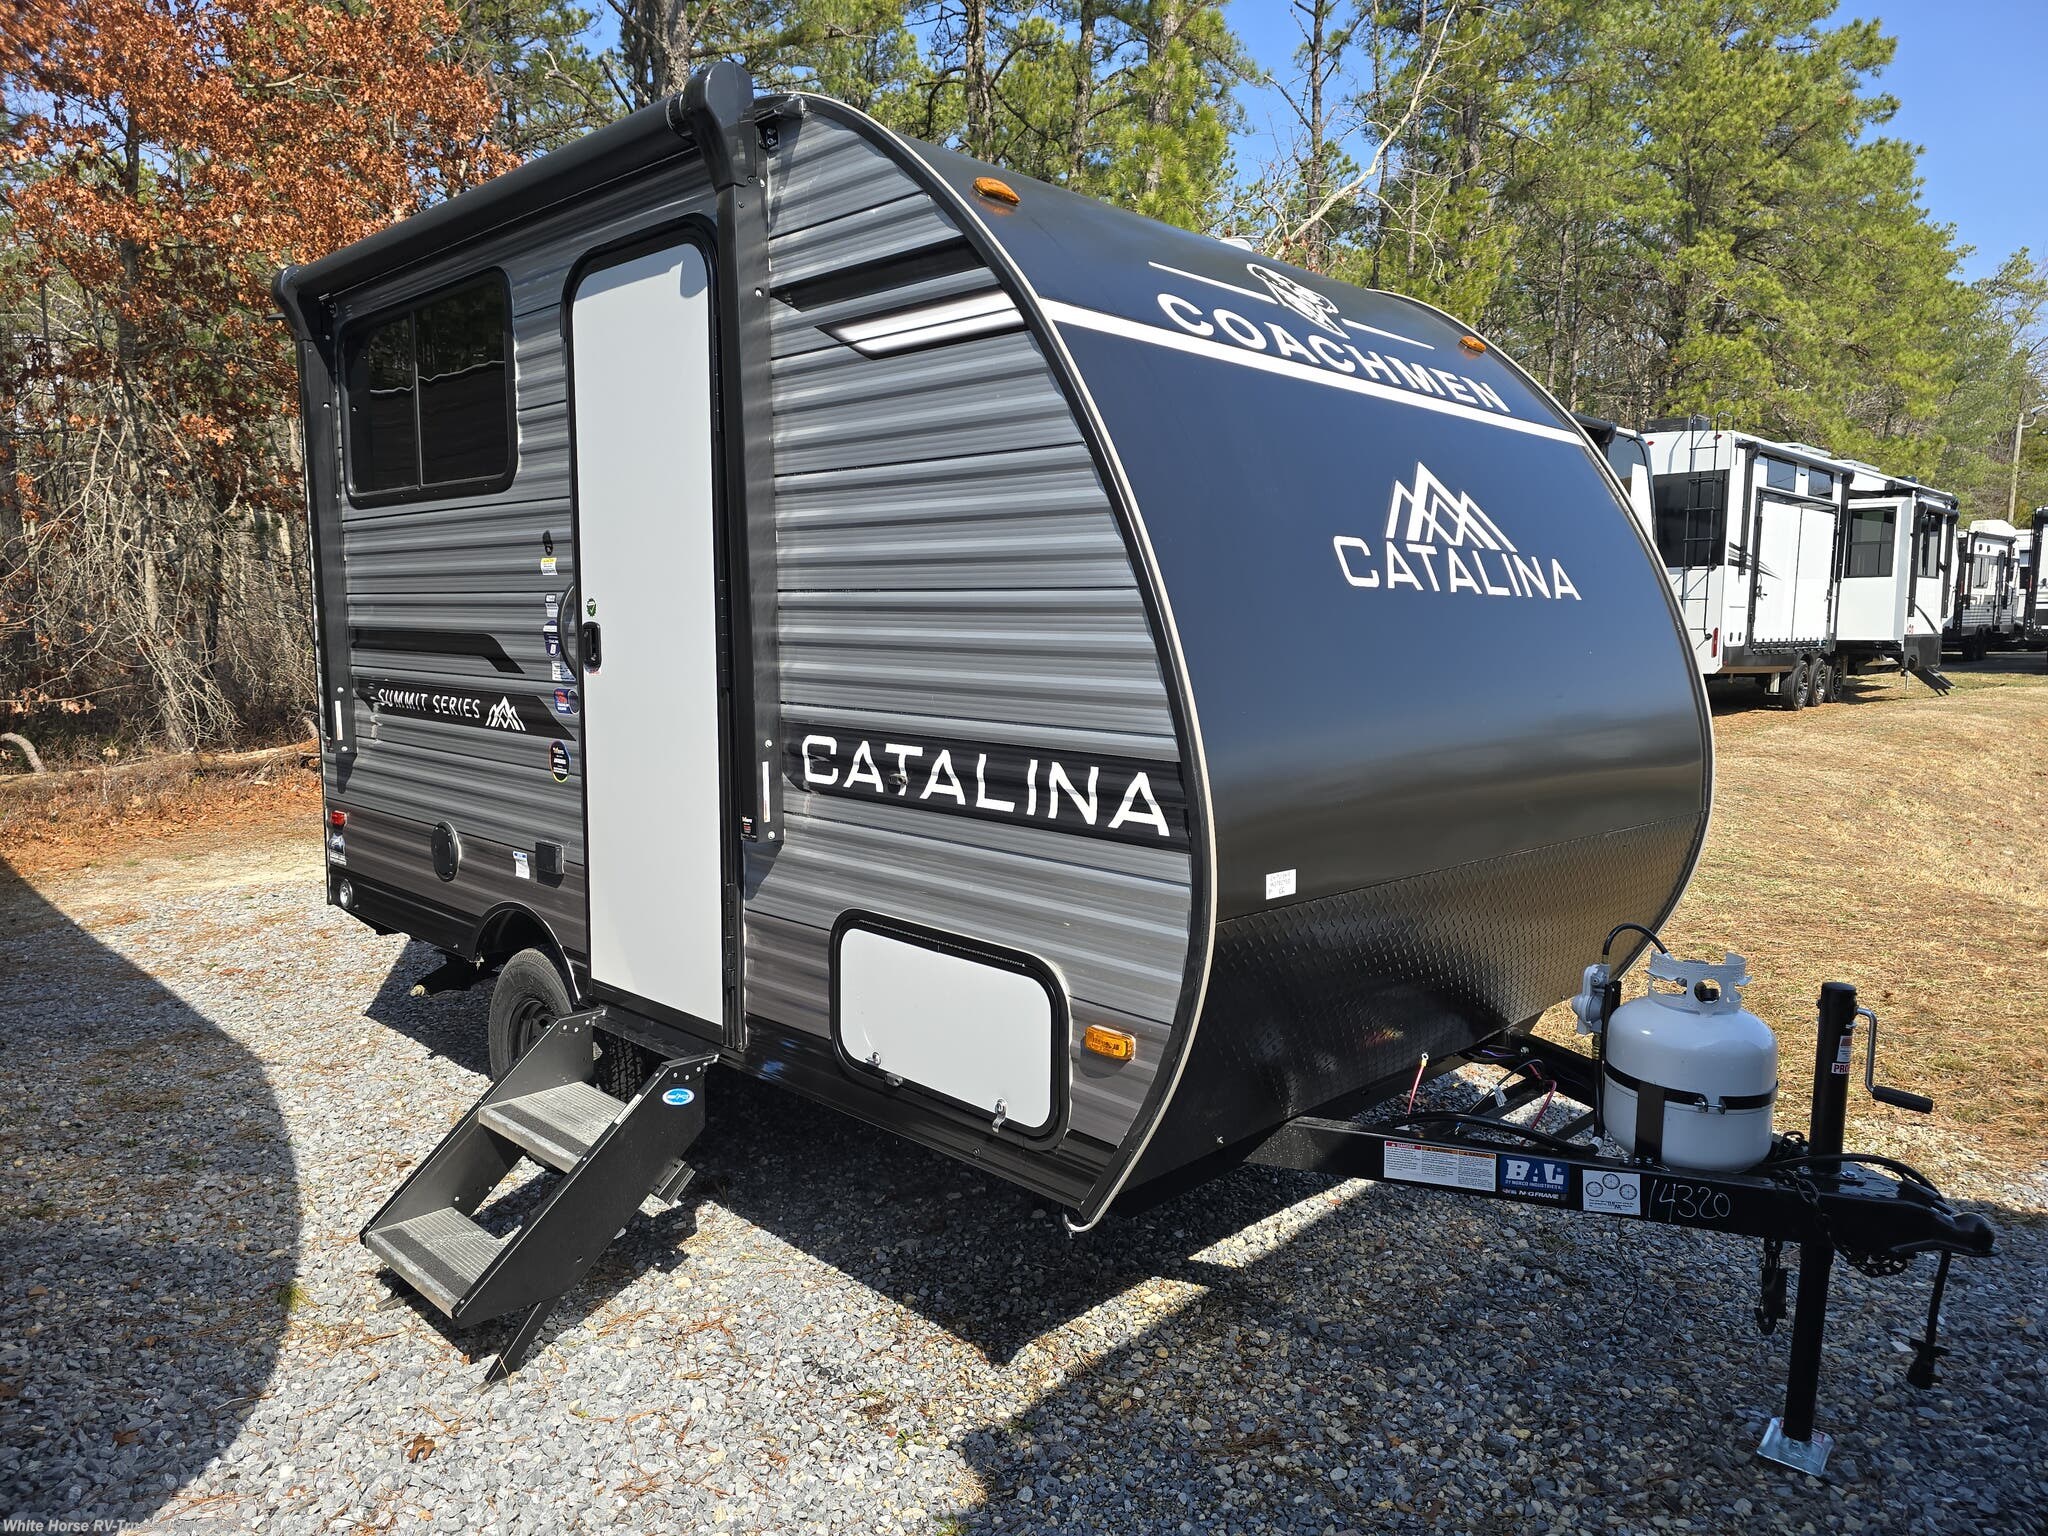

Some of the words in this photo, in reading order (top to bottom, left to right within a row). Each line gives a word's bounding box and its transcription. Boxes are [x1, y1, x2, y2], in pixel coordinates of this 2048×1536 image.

[1157, 293, 1511, 412] COACHMEN
[1333, 536, 1582, 601] CATALINA
[378, 688, 430, 712] SUMMIT
[432, 694, 481, 719] SERIES
[802, 734, 1170, 837] CATALINA
[1505, 1159, 1564, 1185] BAL
[1648, 1179, 1731, 1223] 14320
